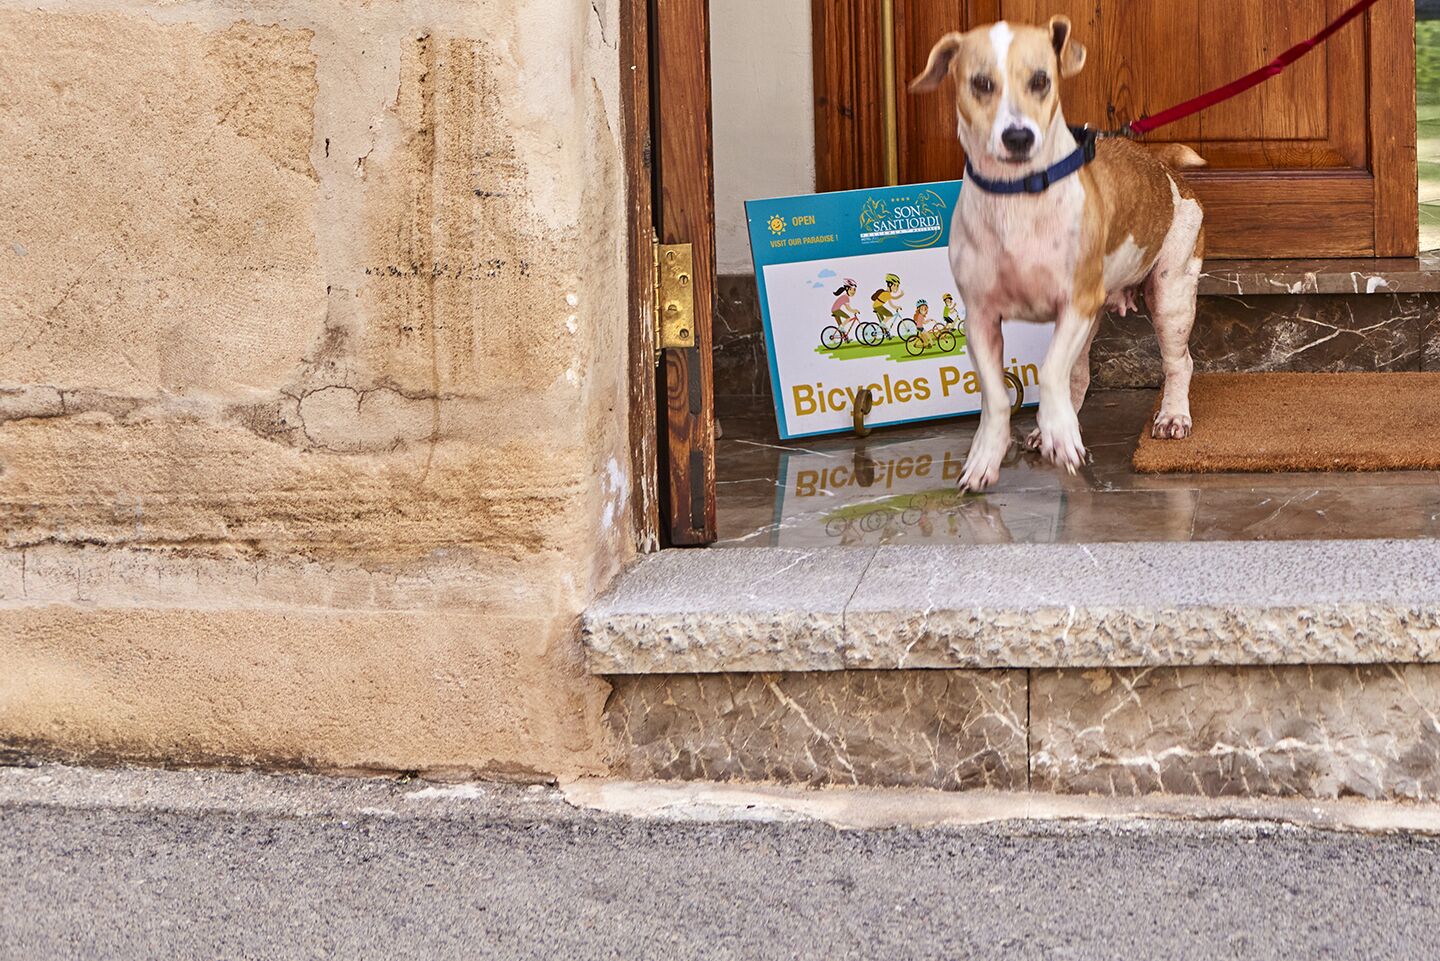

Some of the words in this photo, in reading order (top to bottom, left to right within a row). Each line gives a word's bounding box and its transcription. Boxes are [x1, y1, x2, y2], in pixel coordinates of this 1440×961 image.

[893, 205, 921, 219] SON
[792, 215, 816, 227] OPEN
[873, 217, 904, 232] SANT
[904, 215, 940, 231] JORDI
[770, 239, 787, 248] VISIT
[788, 238, 802, 247] OUR
[802, 234, 834, 245] PARADISE
